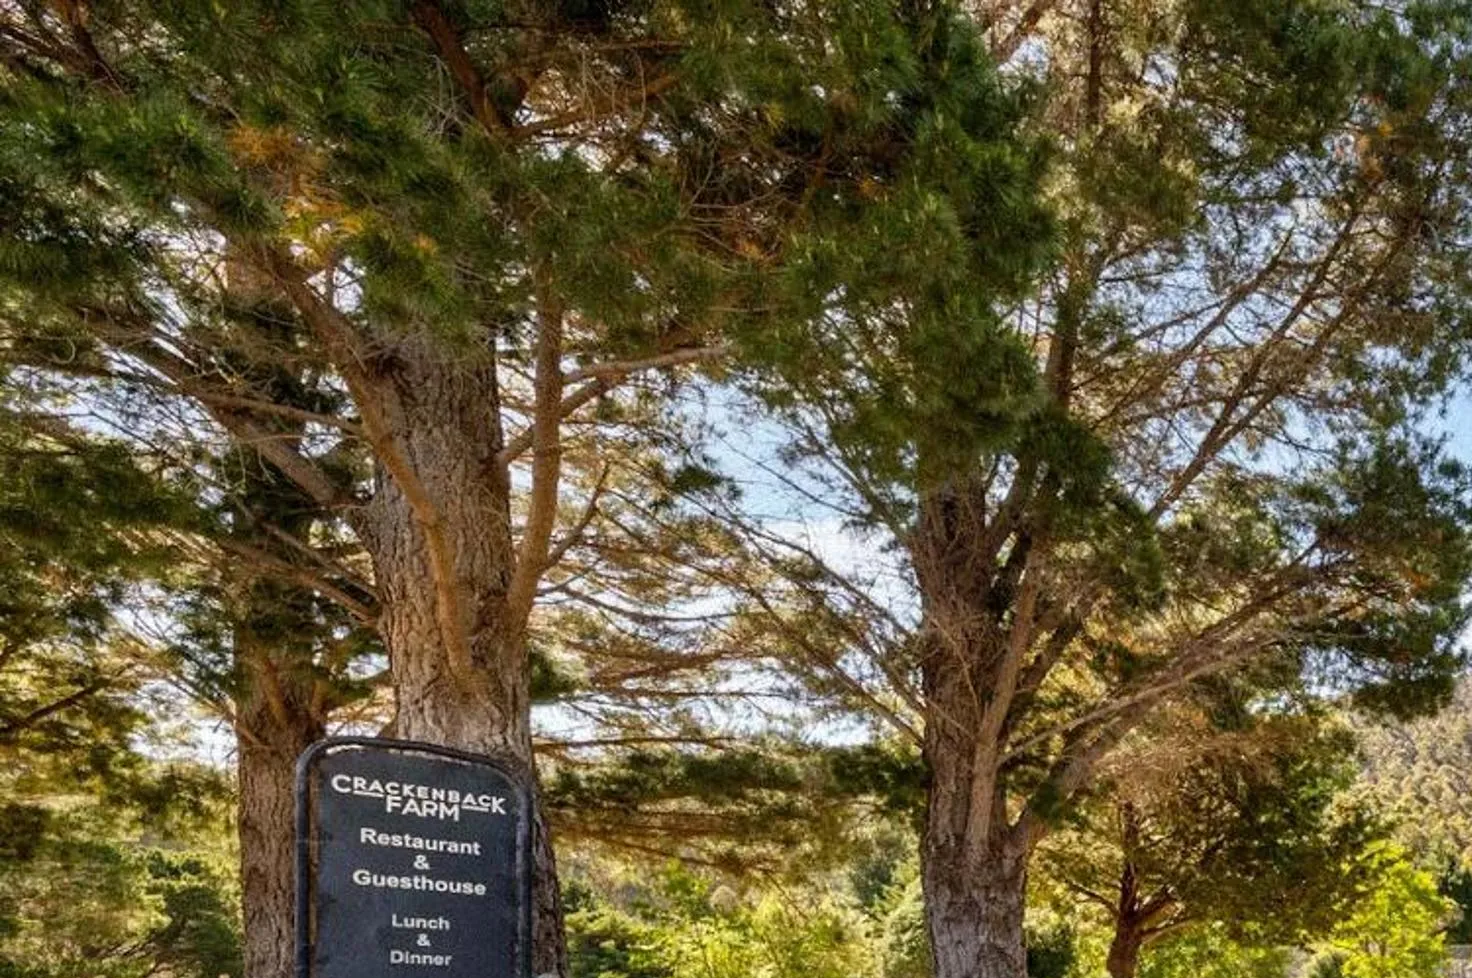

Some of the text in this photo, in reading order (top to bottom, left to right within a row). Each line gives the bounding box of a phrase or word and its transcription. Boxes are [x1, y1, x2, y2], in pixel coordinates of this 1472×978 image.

[331, 774, 507, 815] CRACKENBACK
[385, 796, 461, 822] FARM
[360, 827, 482, 856] Restaurant
[413, 855, 430, 871] &
[352, 870, 487, 896] Guesthouse
[391, 913, 450, 930] Lunch
[416, 933, 431, 947] &
[390, 950, 453, 967] Dinner
